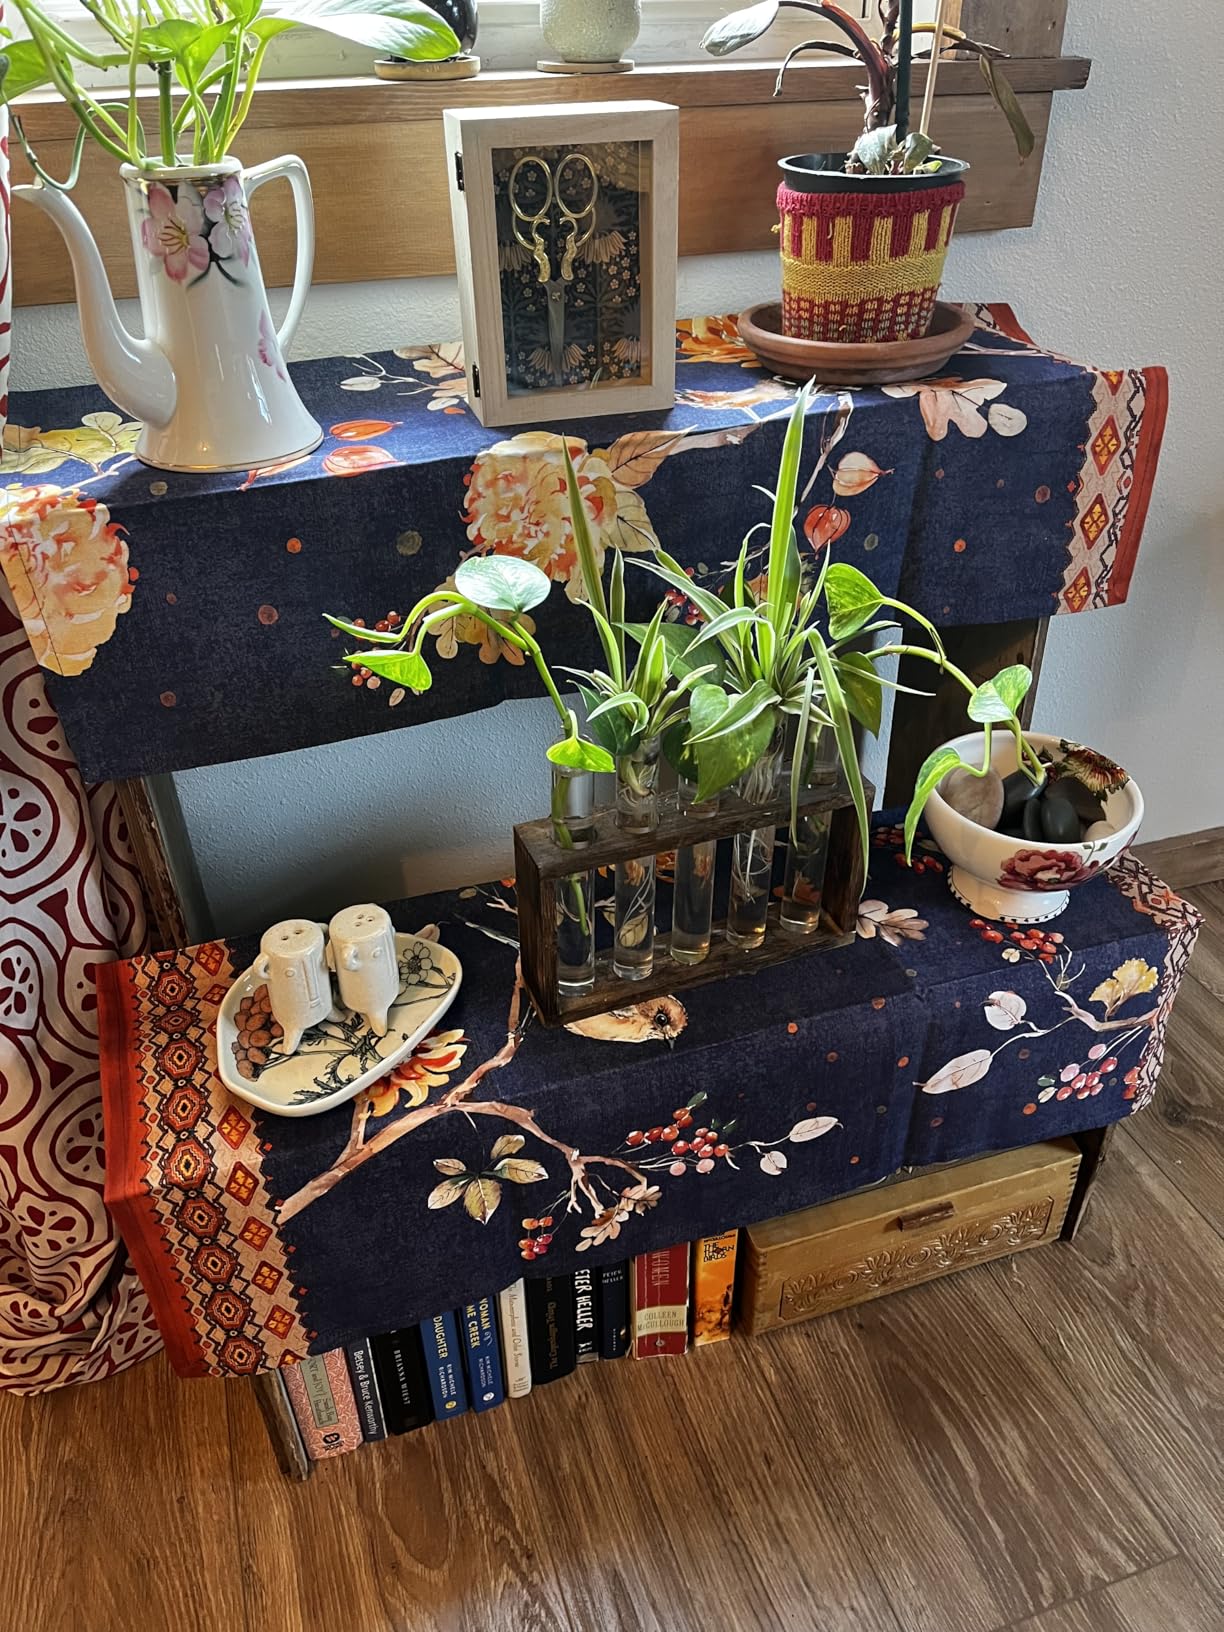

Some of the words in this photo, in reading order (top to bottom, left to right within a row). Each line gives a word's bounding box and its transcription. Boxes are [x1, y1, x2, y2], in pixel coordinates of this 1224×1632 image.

[703, 1242, 719, 1251] THE
[703, 1252, 727, 1262] BIRDS
[652, 1250, 671, 1286] WOMEN
[575, 1268, 593, 1294] ETER
[576, 1295, 594, 1332] HELLER
[644, 1311, 677, 1321] COLLEEN
[433, 1315, 449, 1359] DAUGHTER
[468, 1320, 481, 1349] CREEK
[354, 1349, 367, 1373] Betsey
[358, 1373, 368, 1381] &
[394, 1349, 406, 1382] BRIANNA
[401, 1382, 411, 1406] WIEST
[439, 1366, 448, 1398] RICHARDSON
[448, 1374, 457, 1396] MICHELE
[486, 1365, 494, 1386] MICHELE
[360, 1380, 372, 1400] Bruce
[366, 1400, 379, 1435] Kenworthy
